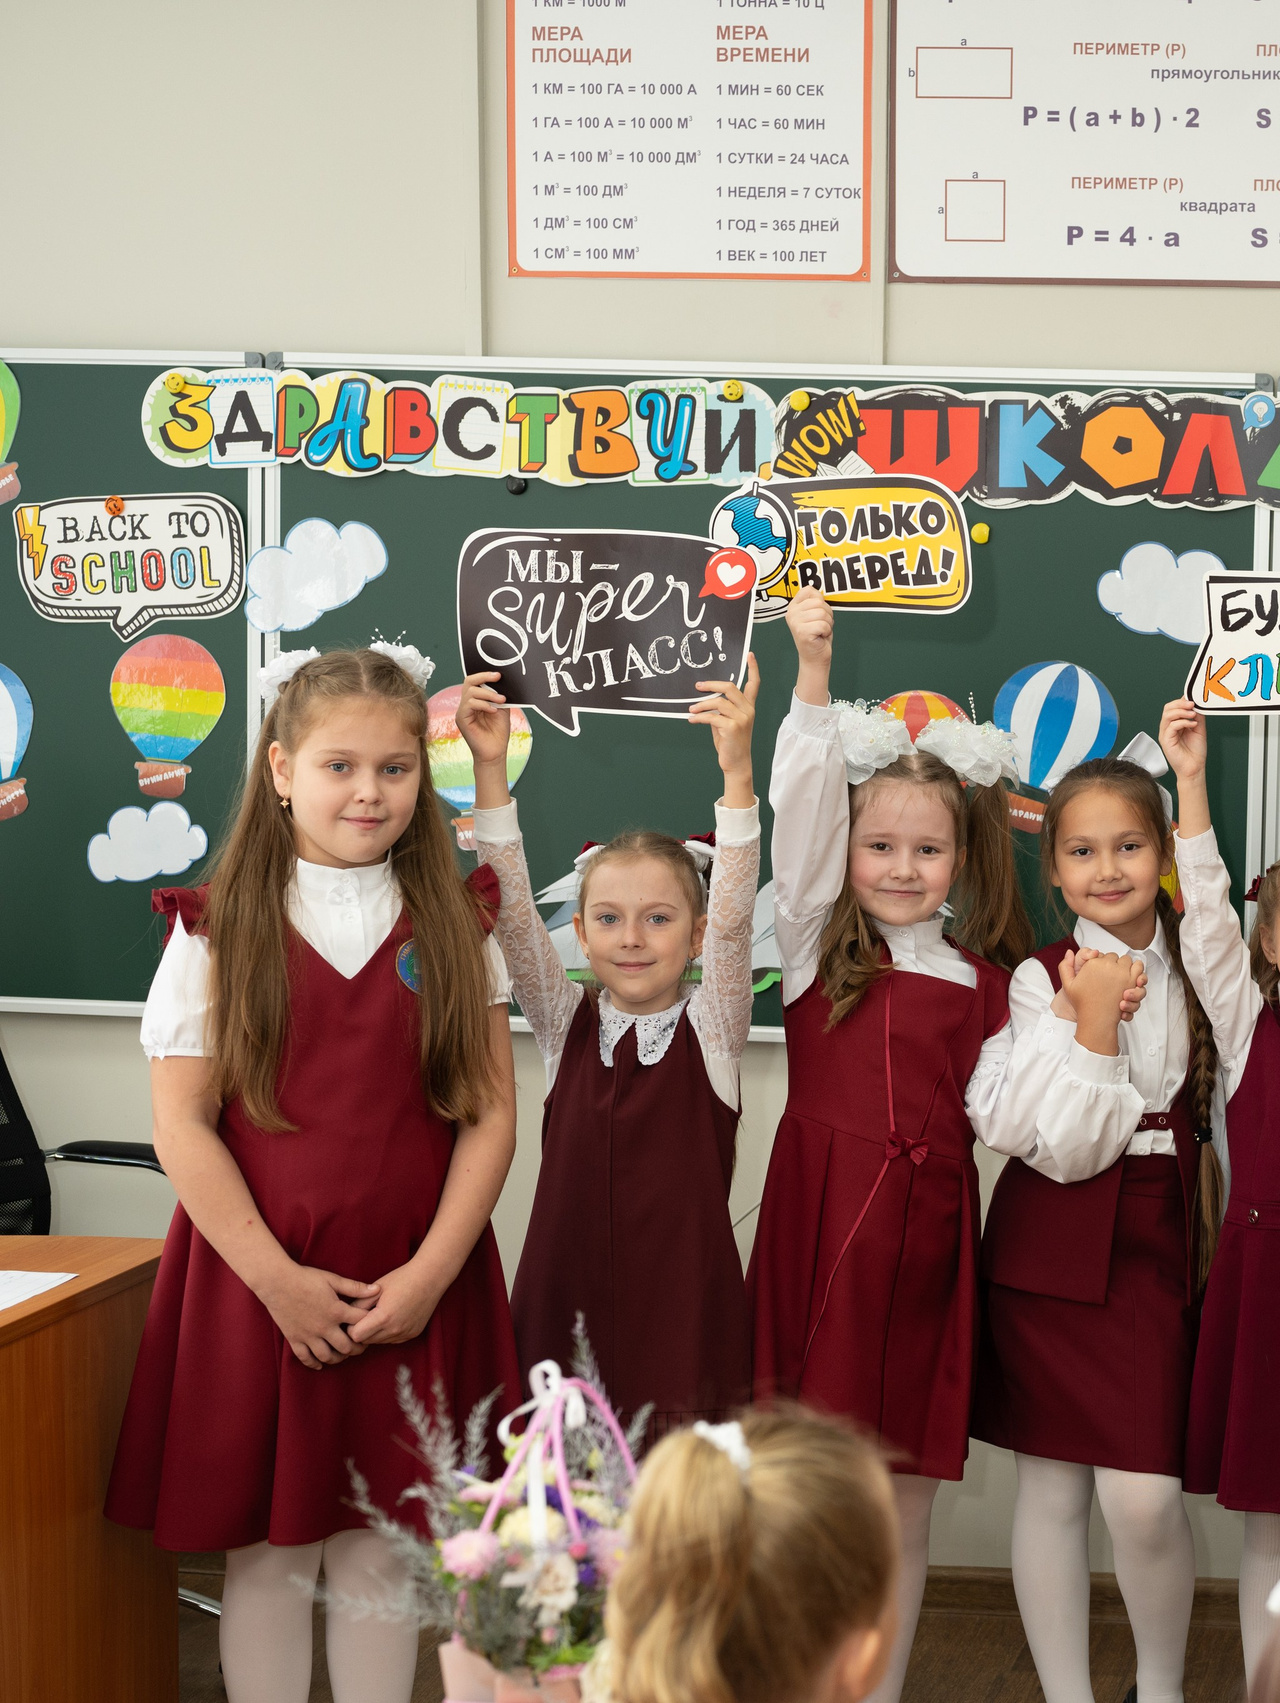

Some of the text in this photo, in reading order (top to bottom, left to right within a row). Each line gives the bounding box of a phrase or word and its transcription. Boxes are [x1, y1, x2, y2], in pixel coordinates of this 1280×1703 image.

[531, 26, 584, 42] МЕРА
[716, 25, 769, 41] МЕРА
[716, 47, 810, 63] ВРЕМЕНИ
[1073, 43, 1161, 56] ПЕРИМЕТР
[531, 48, 632, 67] ПЛОЩАДИ
[543, 83, 684, 96] КМ 100 ГА 10 000
[727, 84, 825, 97] МИН 60 СЕК
[543, 117, 673, 129] ГА 100 10 000
[727, 118, 826, 131] ЧАС 60 МИН
[570, 151, 672, 164] 100 10 000
[727, 153, 850, 166] СУТКИ 24 ЧАСА
[575, 184, 599, 197] 100
[1071, 177, 1159, 191] ПЕРИМЕТР
[727, 186, 862, 200] НЕДЕЛЯ СУТОК
[1179, 202, 1256, 216] квадрата
[585, 217, 609, 230] 100
[727, 217, 840, 234] ГОД 365 ДНЕЙ
[585, 248, 609, 260] 100
[727, 250, 828, 263] ВЕК 100 ЛЕТ
[159, 378, 758, 483] ЗДРАВСТВУЙ
[776, 391, 867, 480] WOW!
[57, 510, 212, 546] BACK TO
[796, 498, 948, 548] ТОЛЬКО
[50, 546, 221, 596] SCHOOL
[798, 547, 957, 595] ВПЕРЕД!
[474, 564, 707, 676] Super
[546, 626, 728, 700] КЛАСС!
[138, 767, 186, 787] ВНИМАНИЕ
[1008, 807, 1045, 822] АРАНИ
